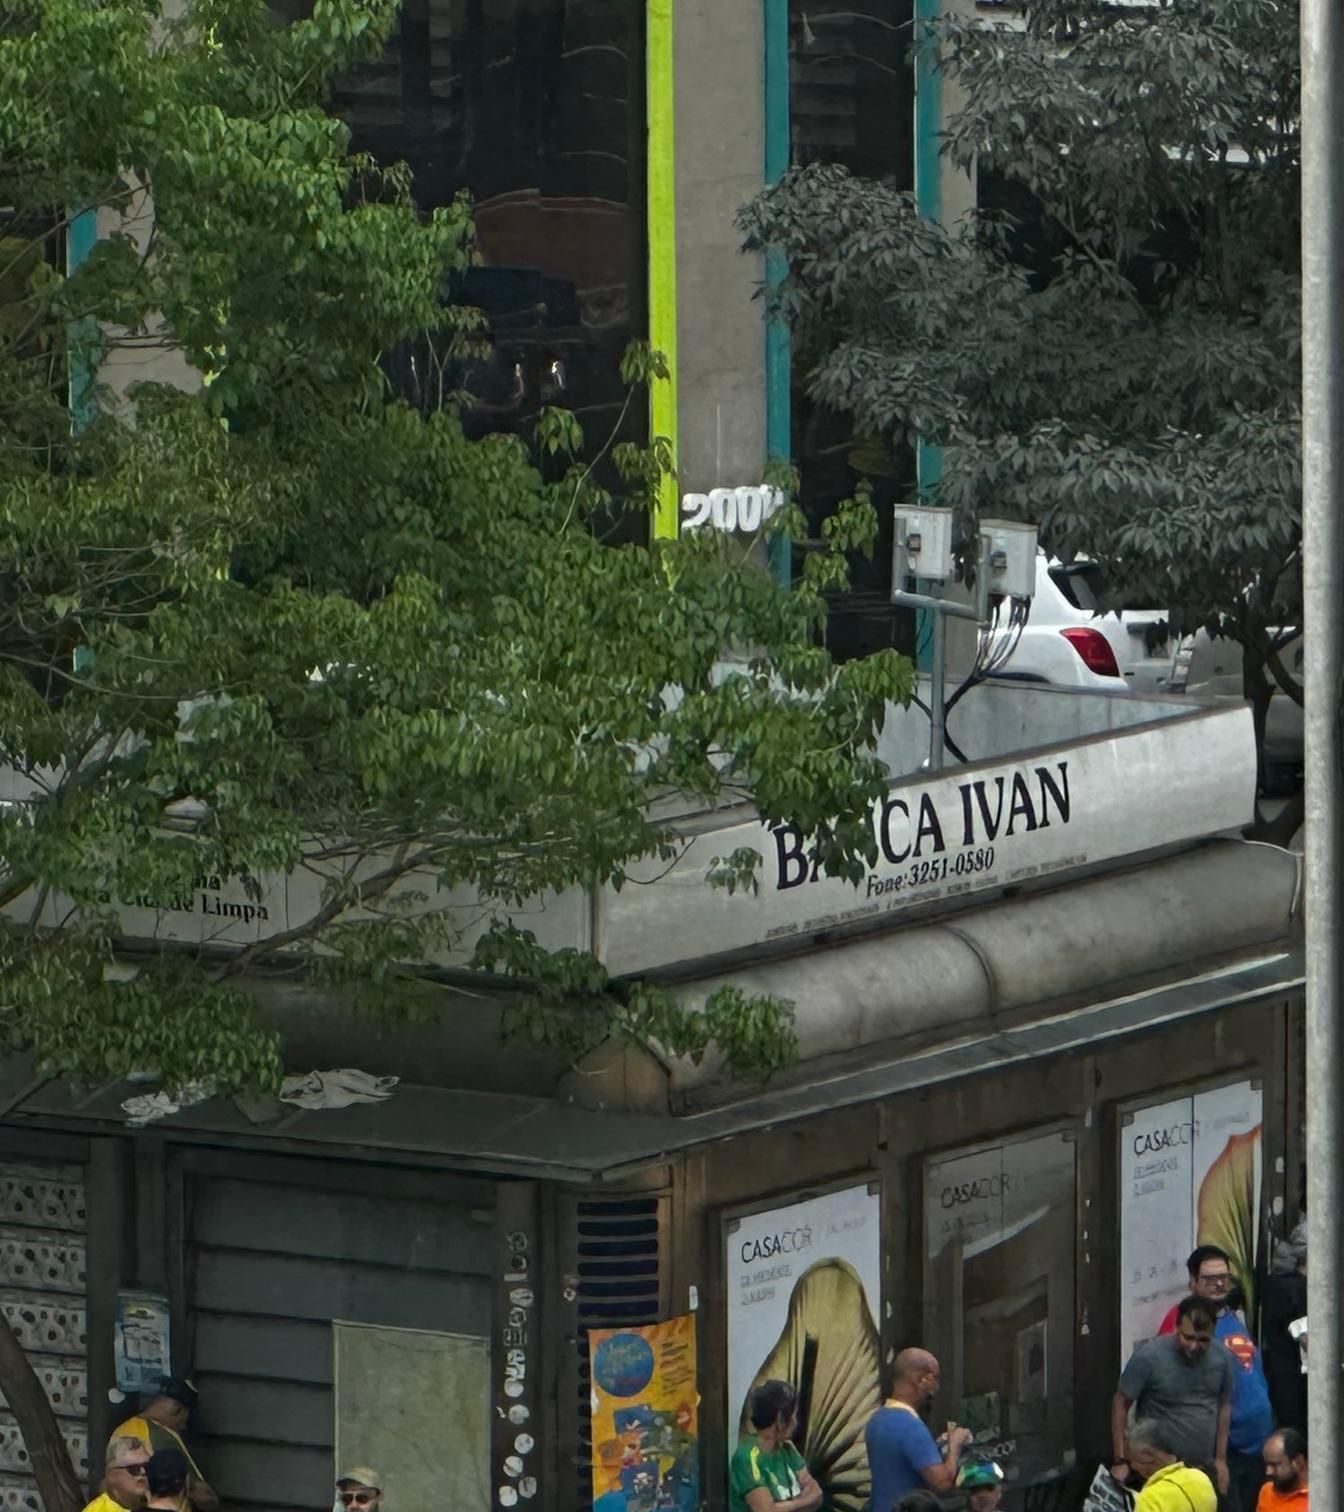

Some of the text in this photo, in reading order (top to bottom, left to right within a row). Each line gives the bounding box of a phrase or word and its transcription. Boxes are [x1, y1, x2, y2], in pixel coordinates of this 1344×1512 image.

[773, 762, 1071, 891] BCA IVAN
[202, 894, 269, 924] Limpa
